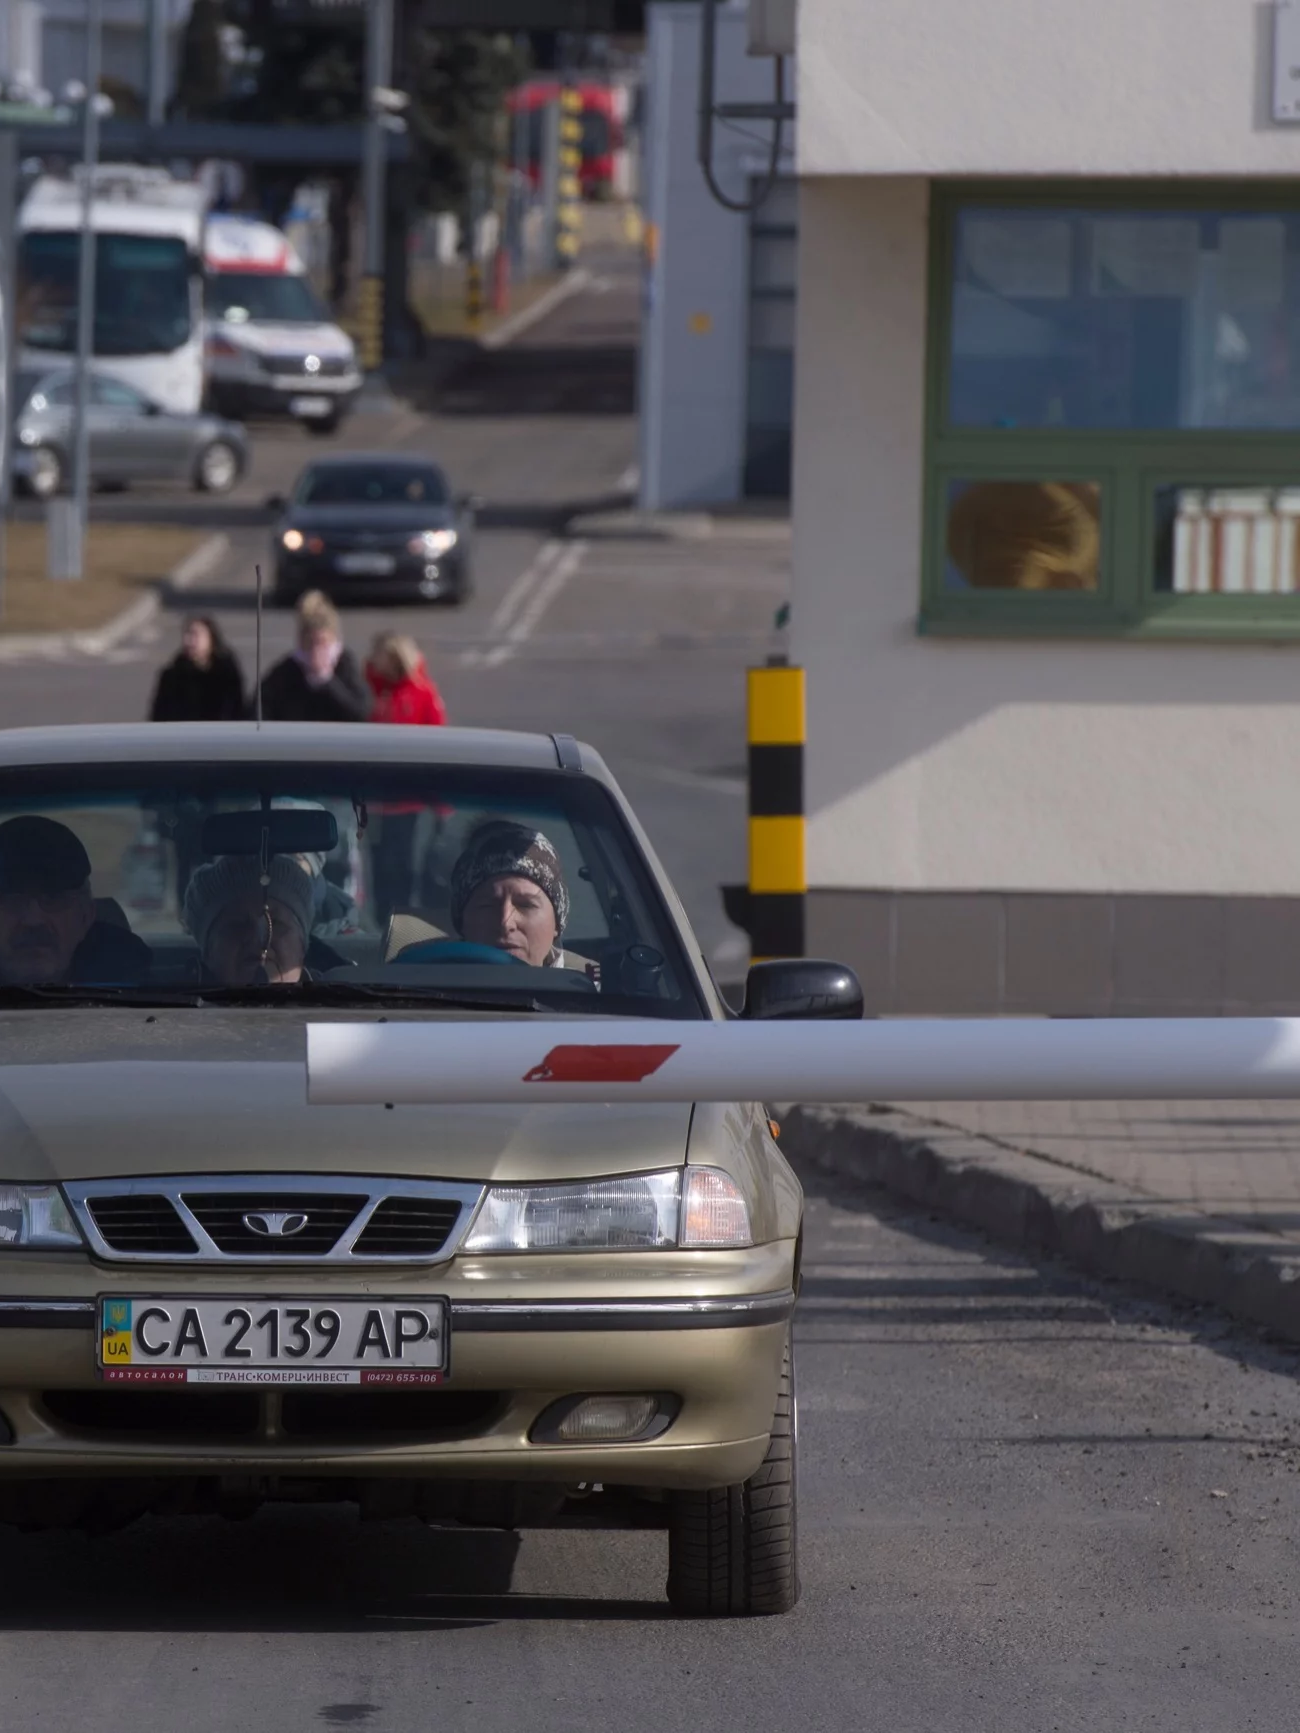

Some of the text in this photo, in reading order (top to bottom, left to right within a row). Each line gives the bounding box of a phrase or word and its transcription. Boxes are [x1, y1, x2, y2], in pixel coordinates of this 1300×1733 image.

[135, 1307, 430, 1359] CA 2139 AP
[107, 1342, 129, 1357] UA
[110, 1370, 184, 1379] автосалон
[367, 1373, 437, 1383] (0472) 655-106
